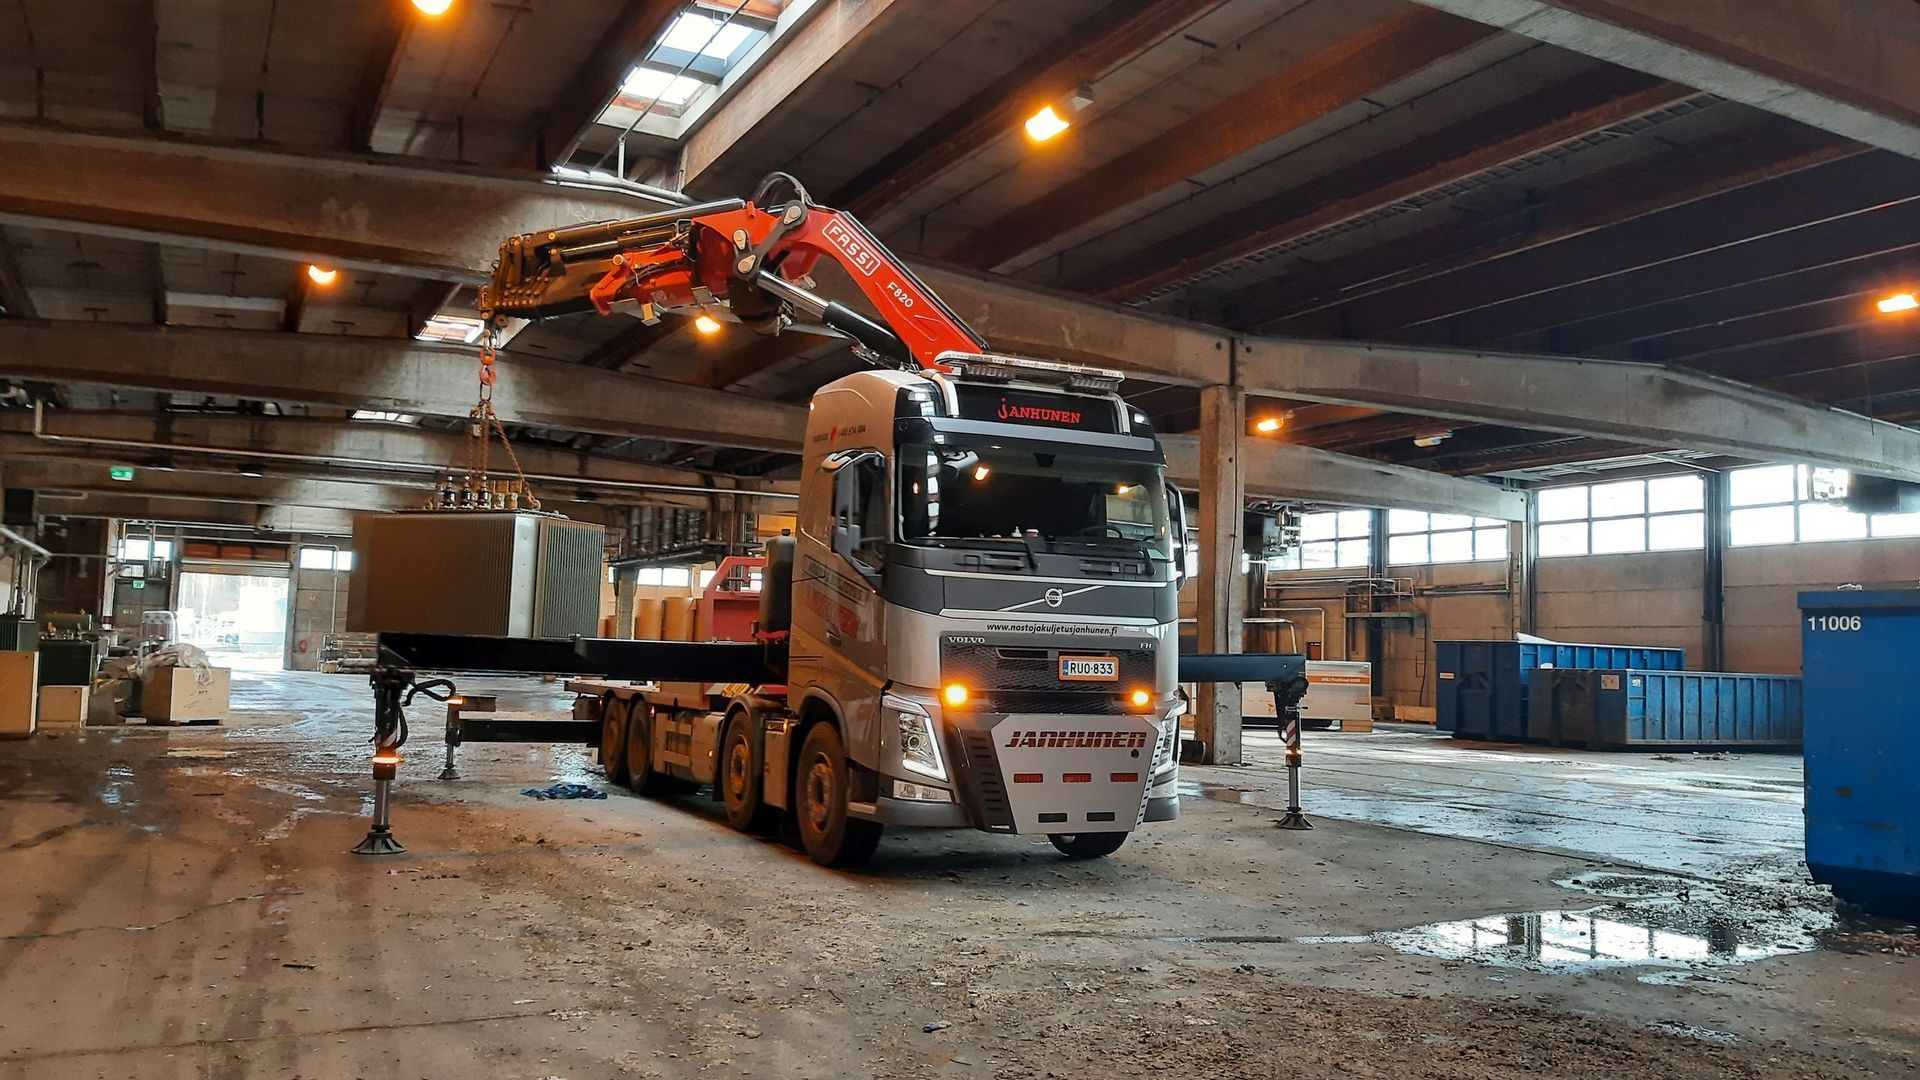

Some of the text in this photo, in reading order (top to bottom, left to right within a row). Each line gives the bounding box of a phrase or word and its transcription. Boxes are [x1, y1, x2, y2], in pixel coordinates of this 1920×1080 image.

[829, 225, 875, 270] FASSI
[886, 281, 914, 308] F820
[986, 623, 1118, 637] www.nostojakuljetusjanhunen.fi
[1808, 615, 1862, 631] 11006
[948, 636, 986, 644] VOLVO
[1005, 731, 1147, 748] JANHUNEN
